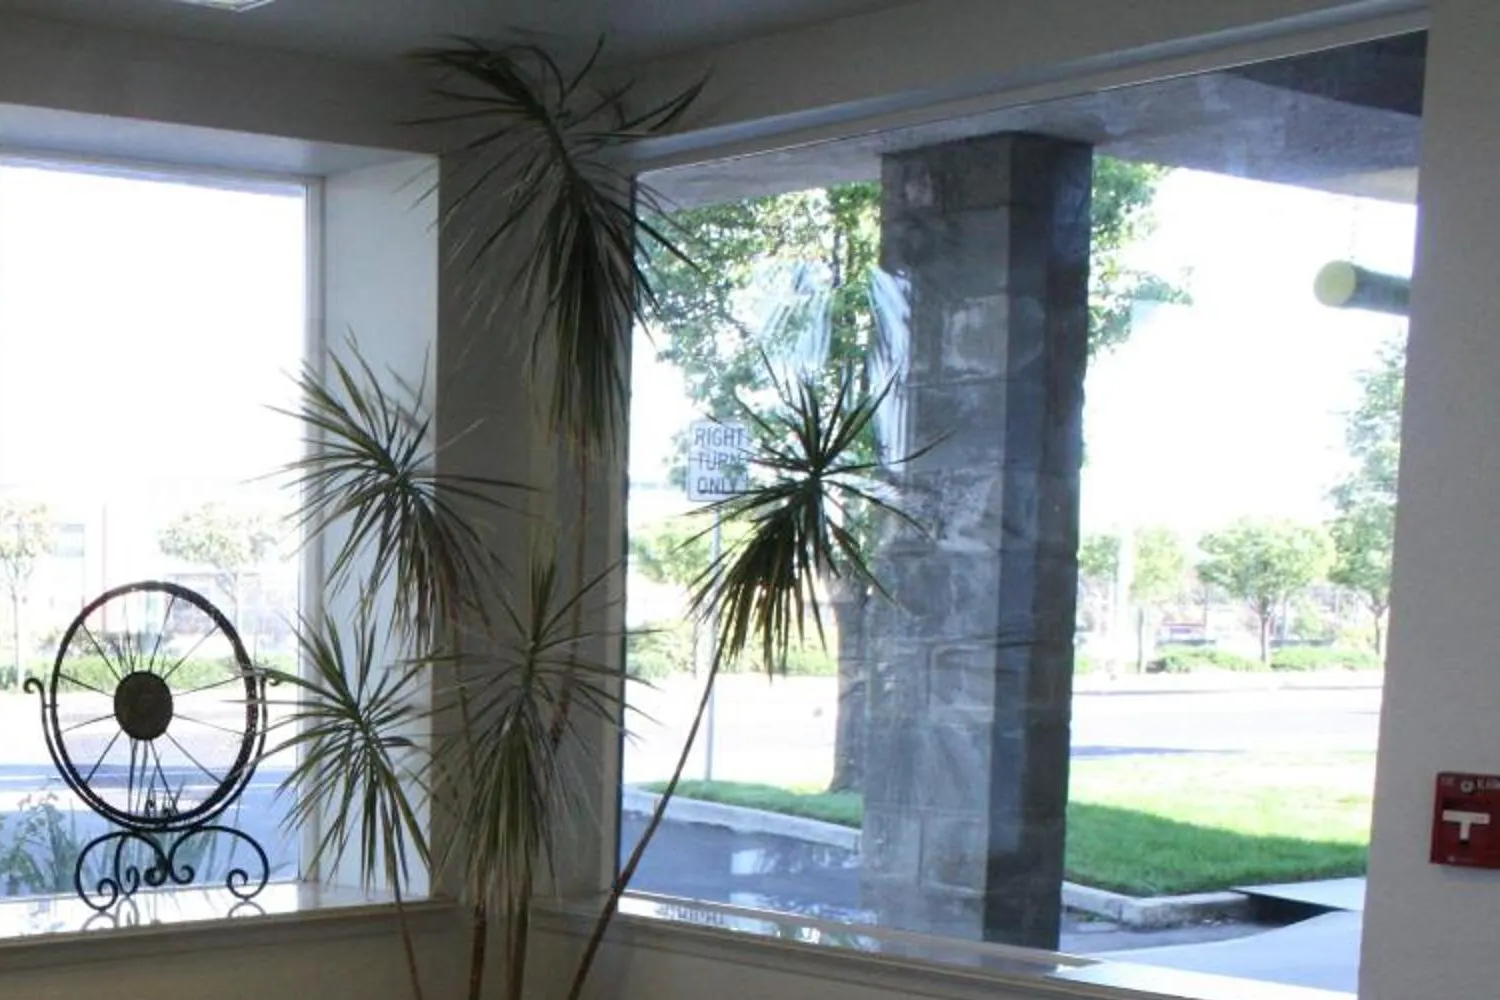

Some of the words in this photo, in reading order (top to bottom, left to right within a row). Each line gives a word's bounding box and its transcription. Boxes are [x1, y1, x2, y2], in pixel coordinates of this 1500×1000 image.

[694, 426, 745, 447] RIGHT
[698, 452, 741, 471] TURN
[697, 477, 739, 495] ONLY
